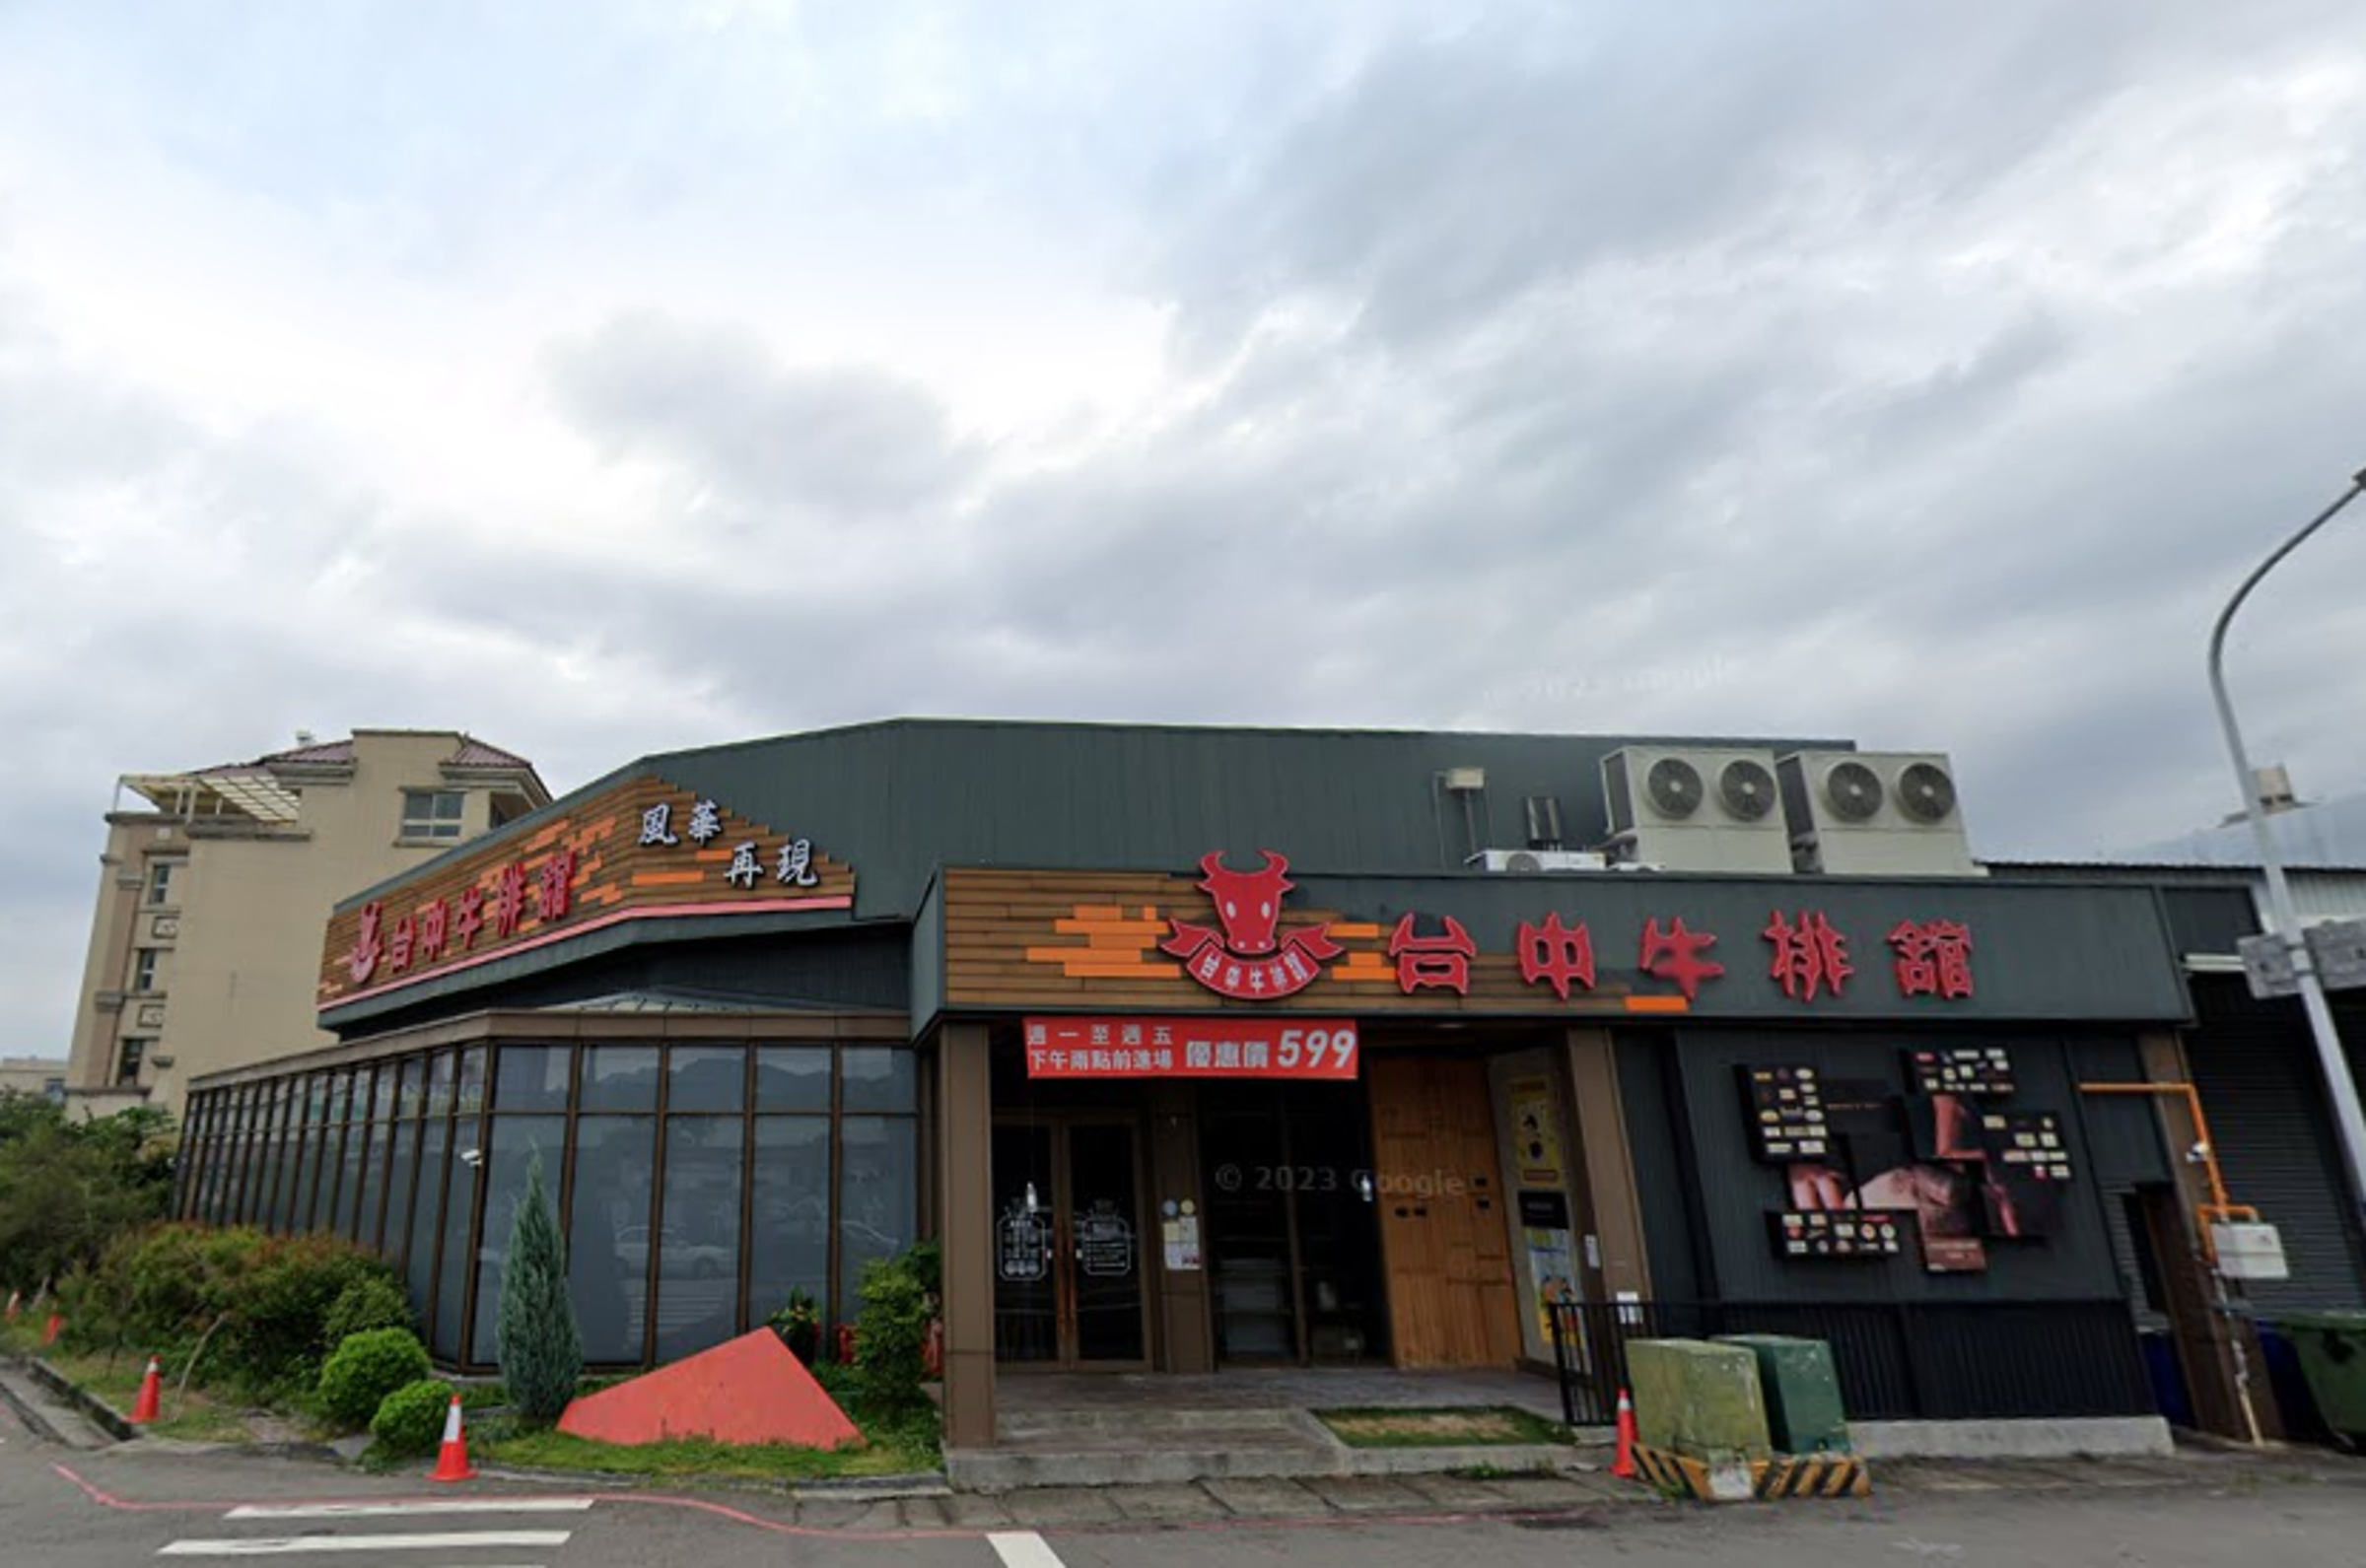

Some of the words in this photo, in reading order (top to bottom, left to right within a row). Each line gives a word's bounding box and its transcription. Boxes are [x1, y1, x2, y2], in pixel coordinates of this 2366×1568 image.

[639, 799, 722, 845] 風華
[724, 839, 818, 888] 再現
[392, 852, 575, 972] 台中牛排館
[1388, 911, 1974, 1002] 台中牛排館
[1028, 1024, 1173, 1045] 週一至週五
[1186, 1041, 1269, 1068] 優惠價
[1278, 1030, 1357, 1067] 599
